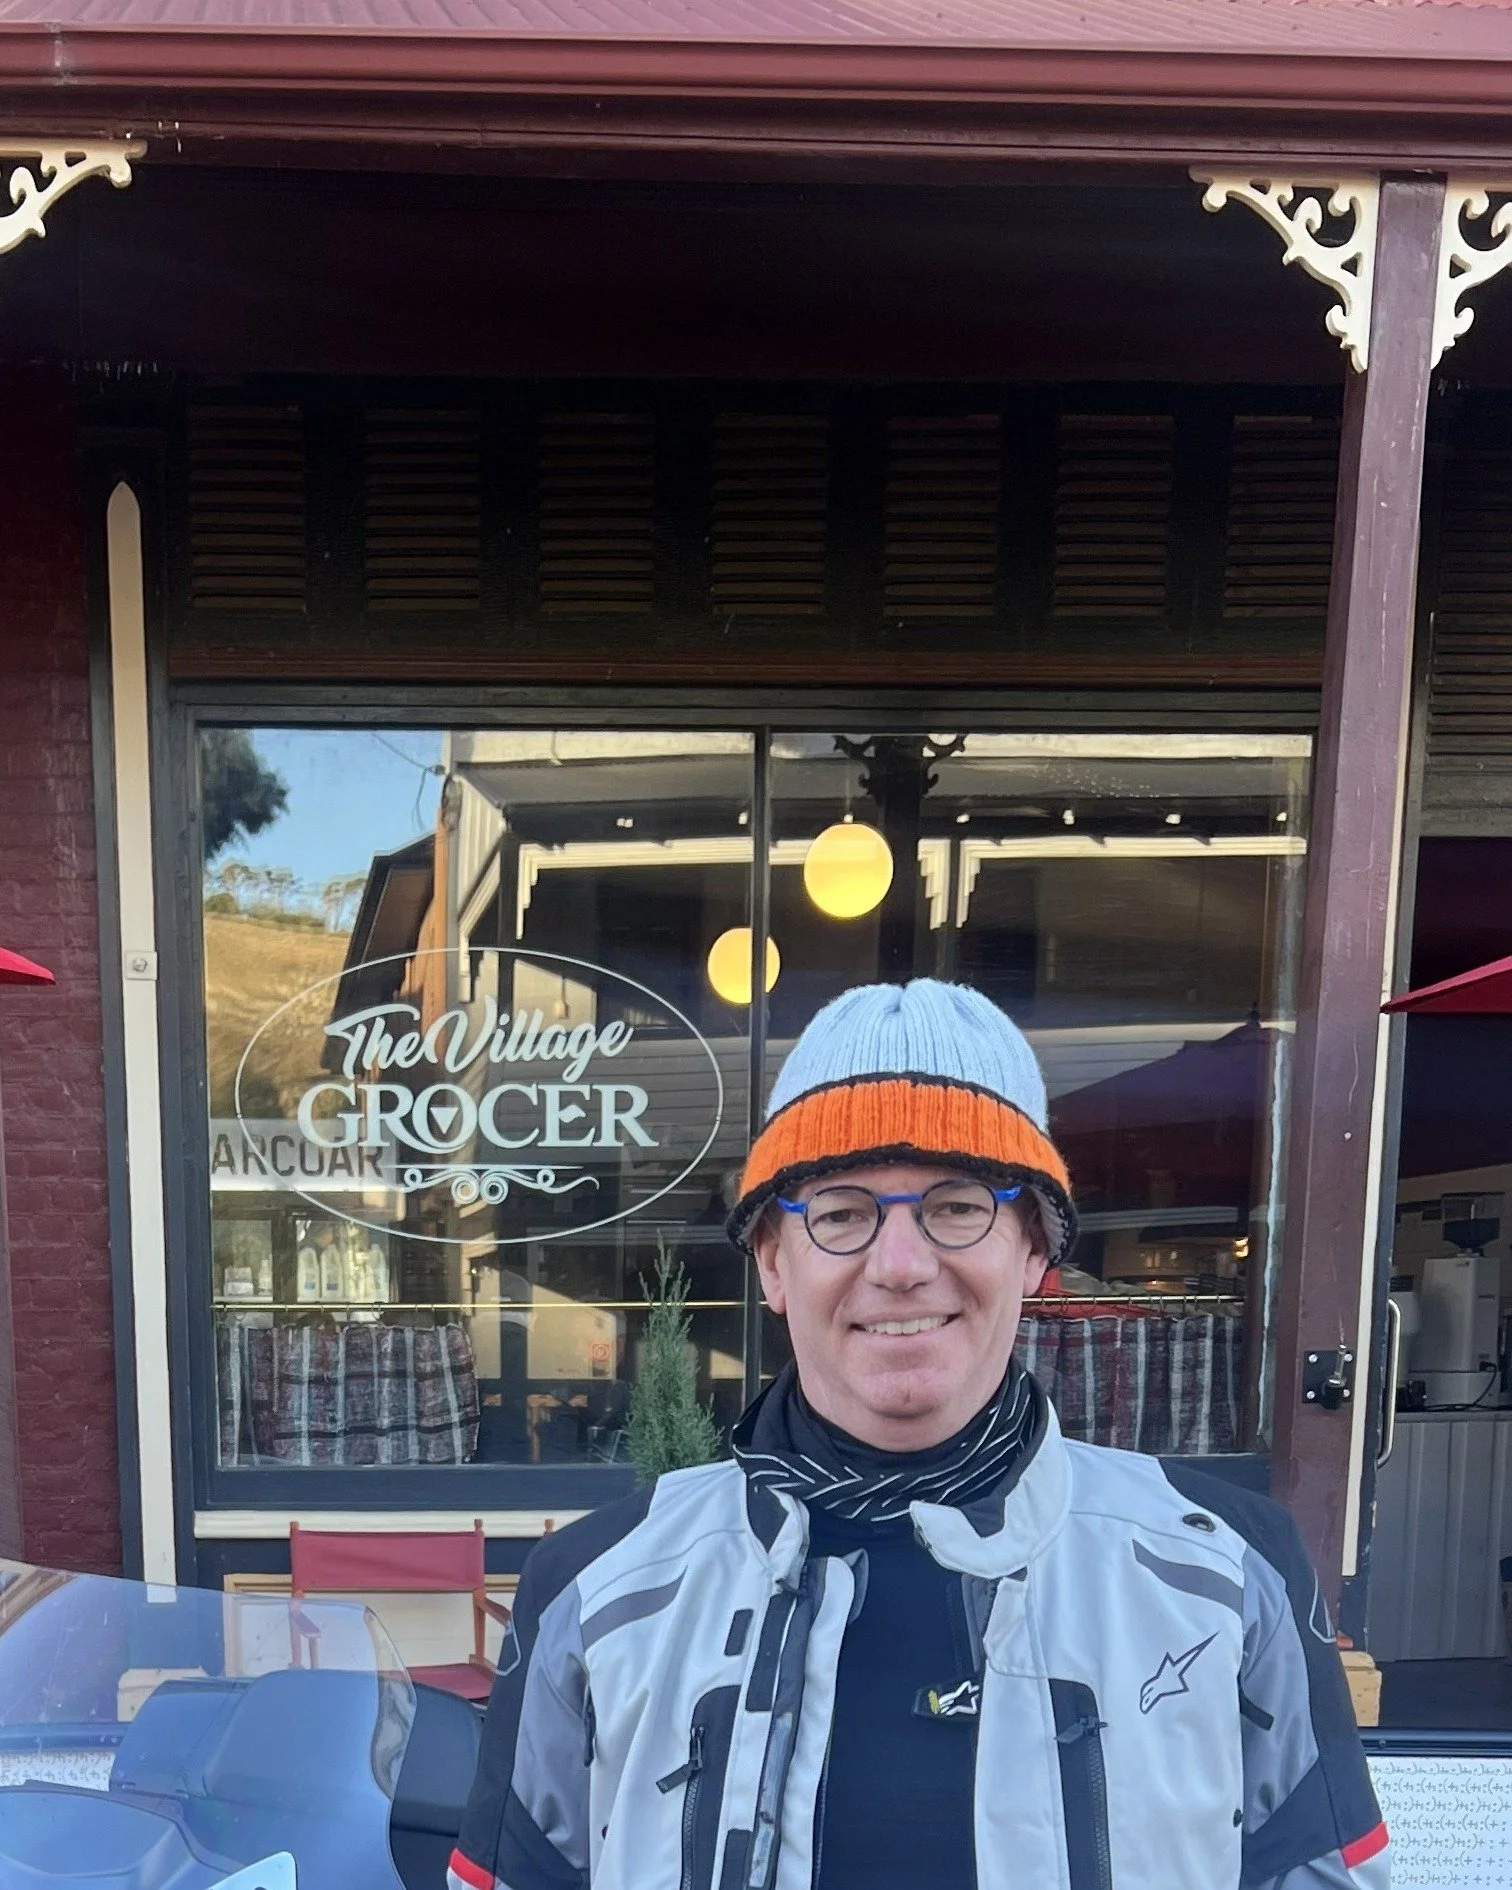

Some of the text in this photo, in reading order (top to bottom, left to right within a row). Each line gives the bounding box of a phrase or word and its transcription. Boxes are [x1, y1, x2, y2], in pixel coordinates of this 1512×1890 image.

[324, 994, 635, 1083] The Village
[297, 1083, 660, 1154] GROCER
